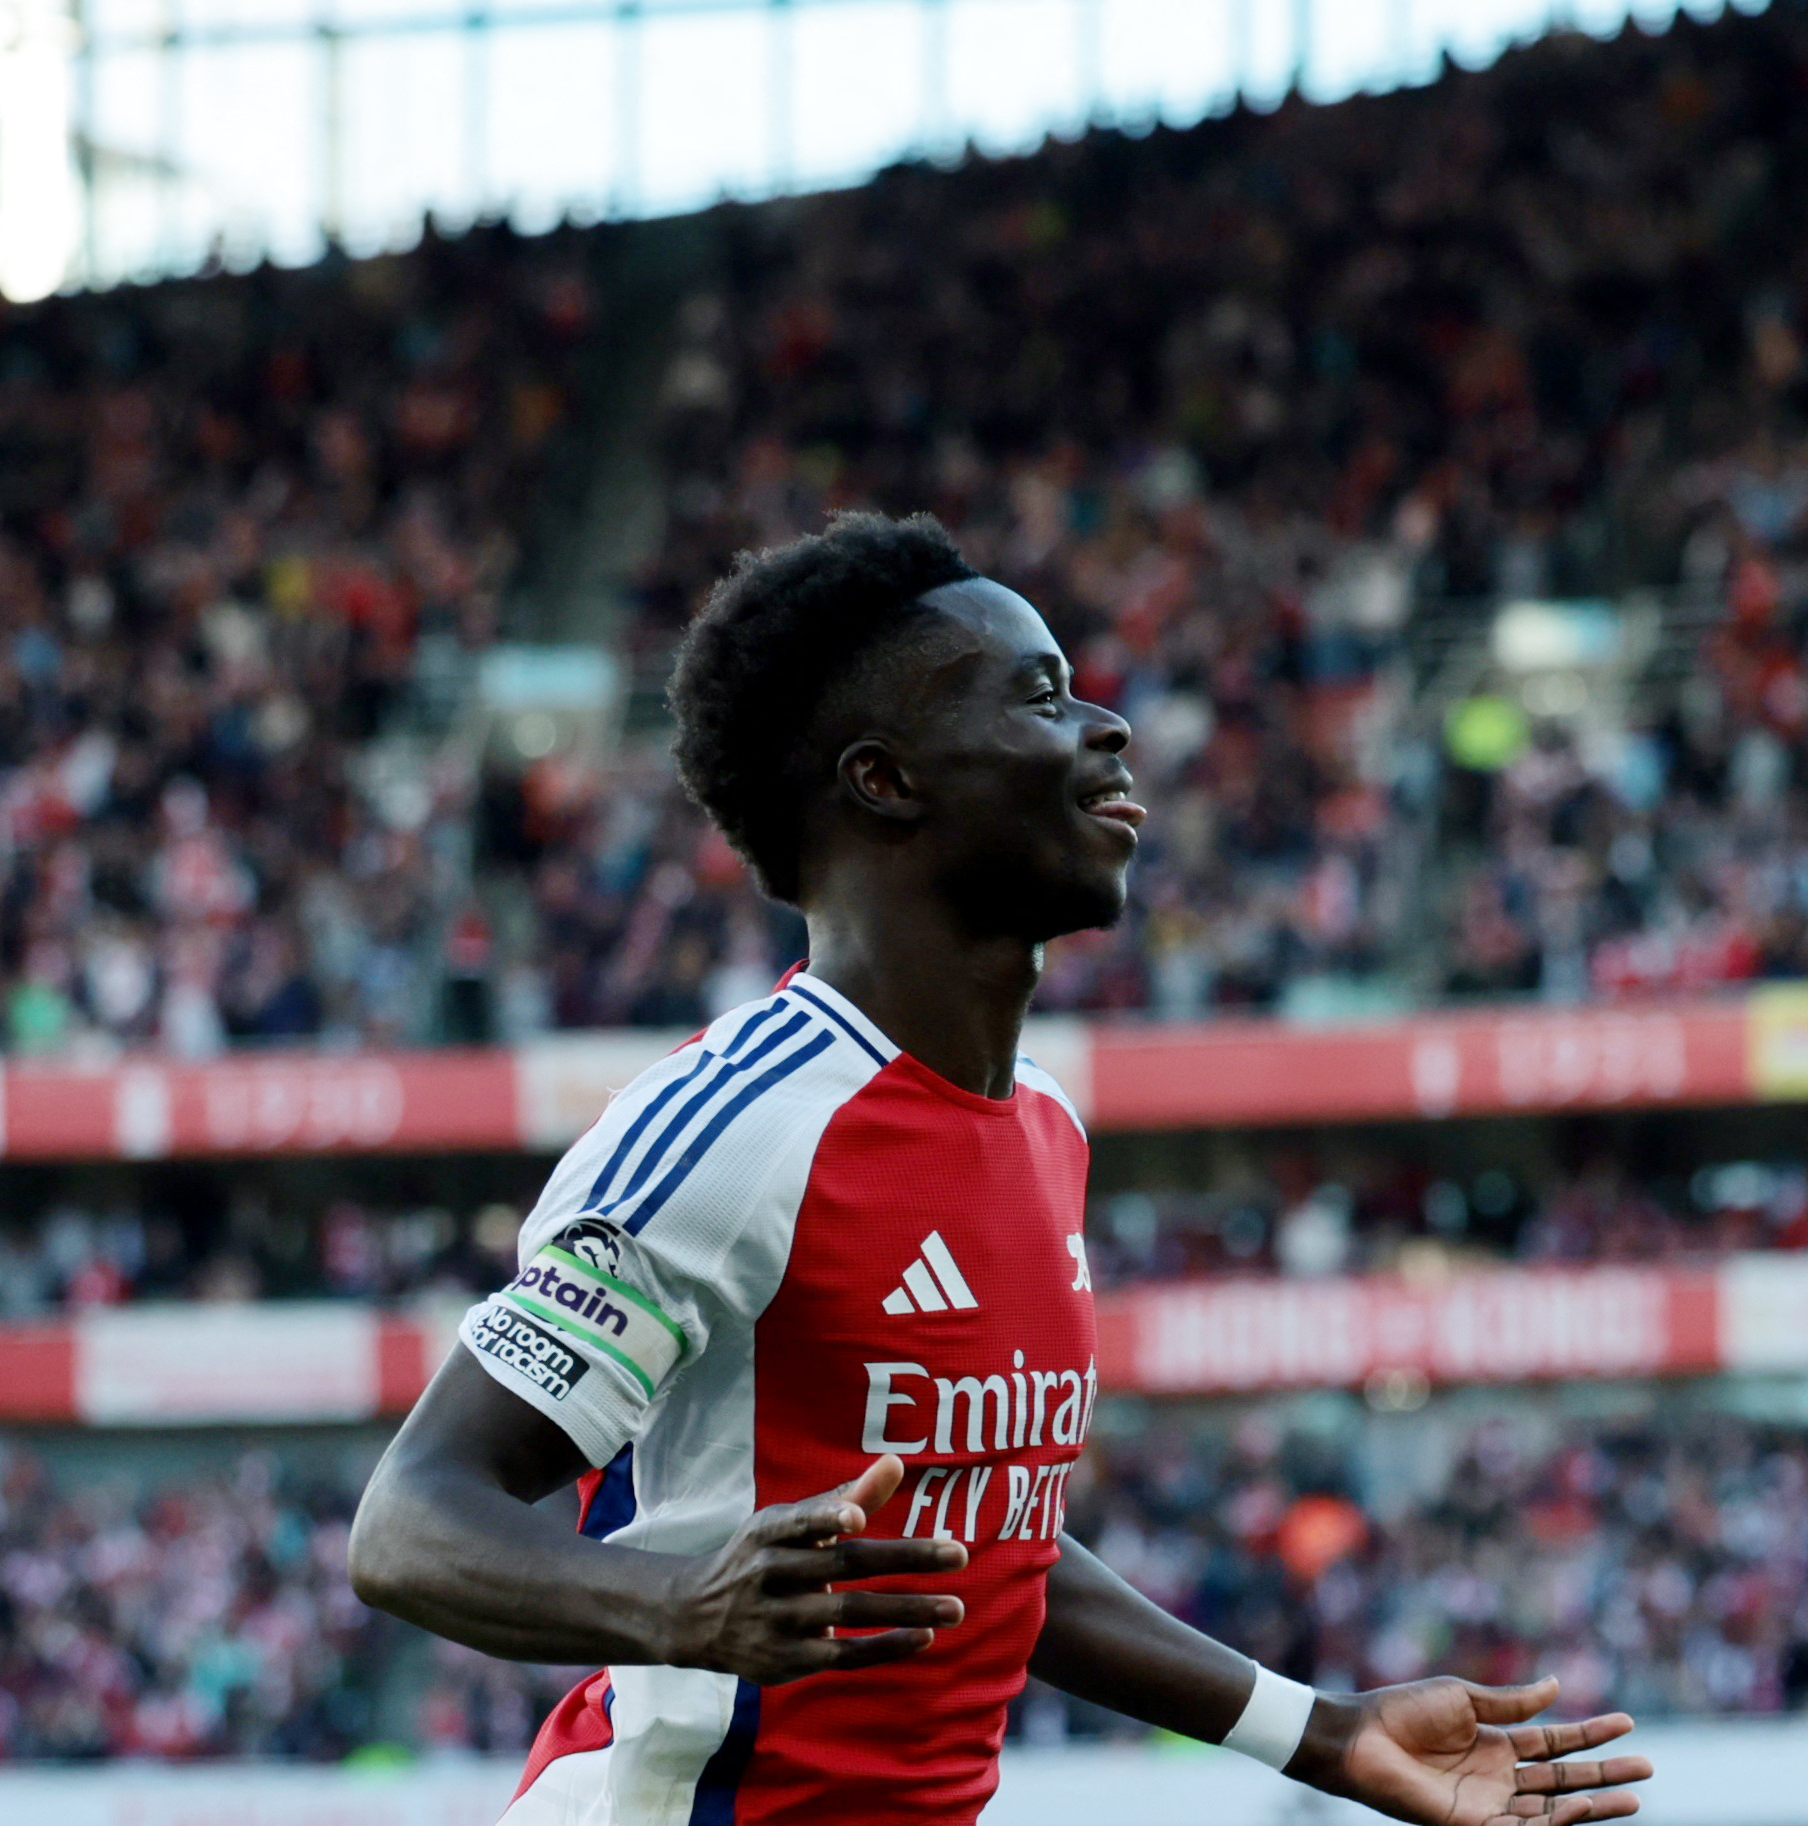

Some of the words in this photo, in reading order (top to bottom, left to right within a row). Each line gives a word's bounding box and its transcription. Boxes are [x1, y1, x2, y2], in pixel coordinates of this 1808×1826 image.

[510, 1265, 629, 1337] ptain
[491, 1333, 571, 1400] racism
[506, 1315, 574, 1375] room
[861, 1348, 1098, 1455] Emirat
[901, 1466, 993, 1543] FLY
[997, 1460, 1075, 1541] BETT
